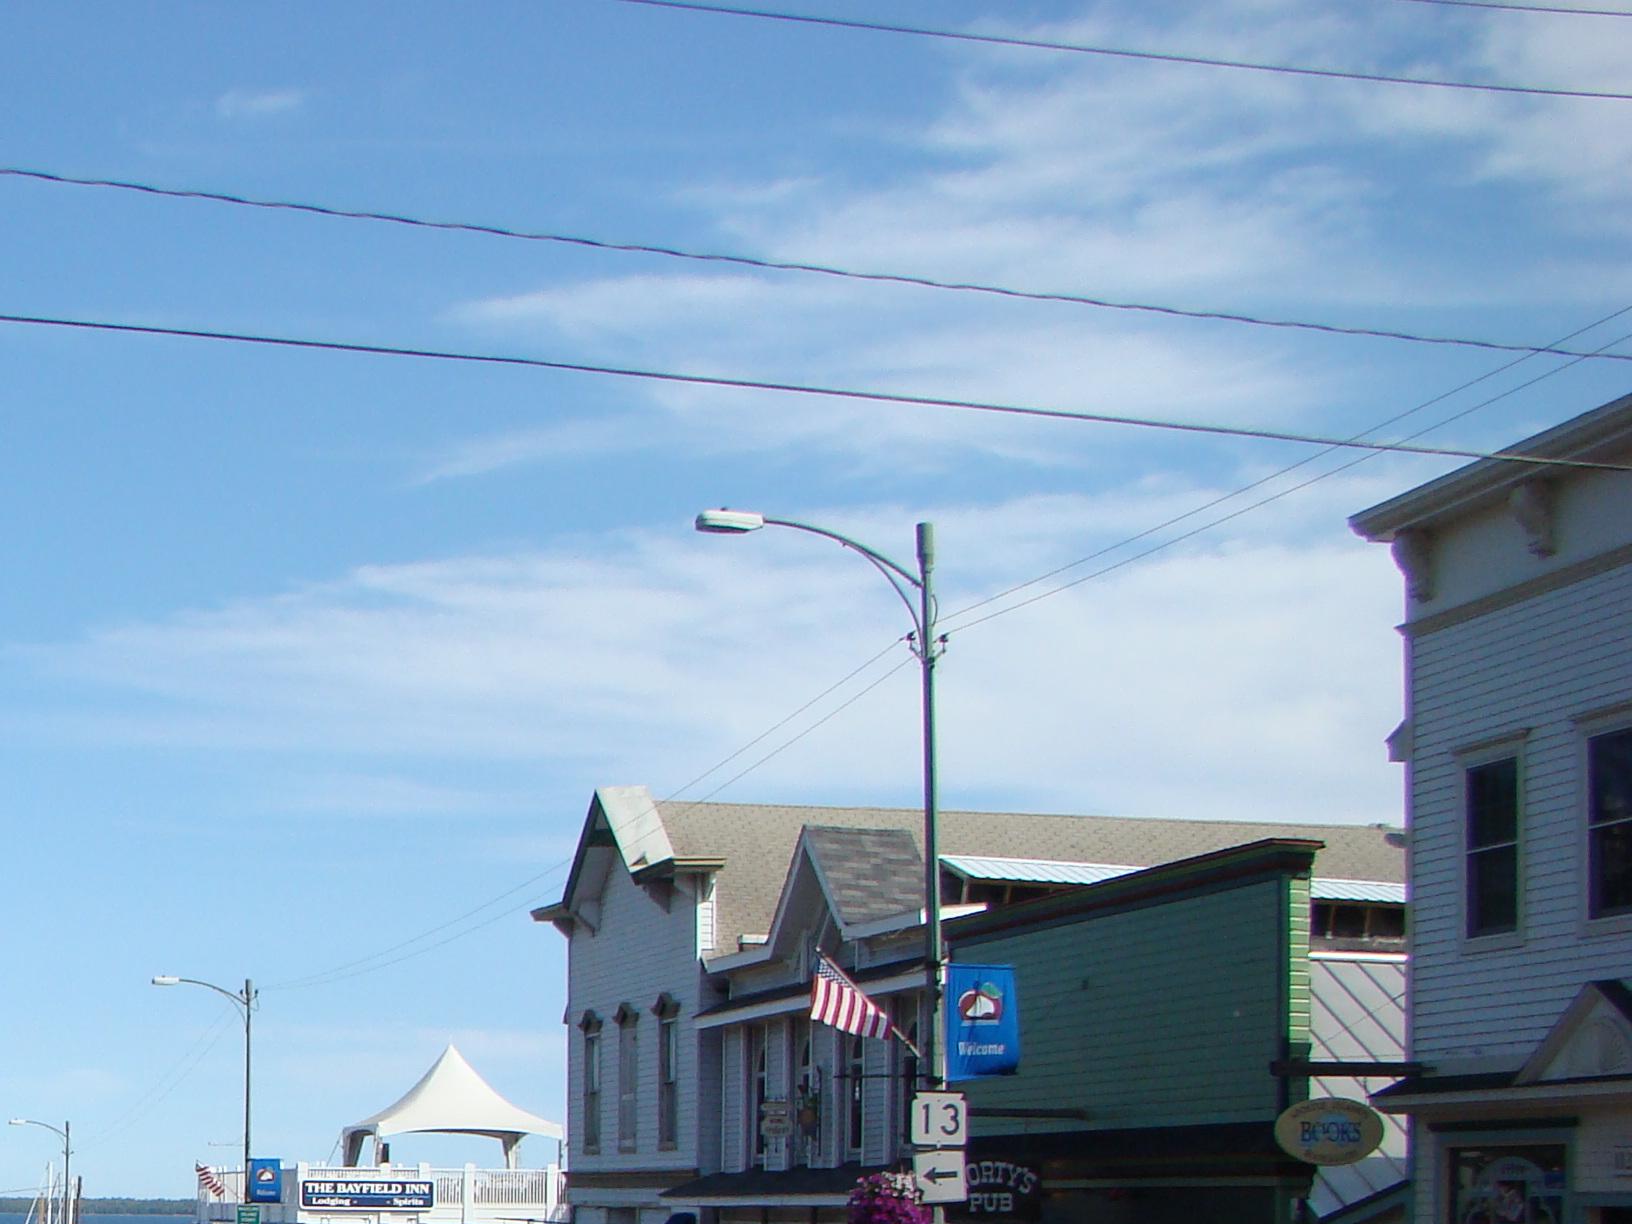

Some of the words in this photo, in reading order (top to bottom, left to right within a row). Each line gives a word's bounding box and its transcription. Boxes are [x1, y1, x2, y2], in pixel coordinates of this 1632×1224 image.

[958, 1041, 1005, 1056] Welcome
[922, 1103, 960, 1135] 13
[1300, 1121, 1361, 1142] BOOKS
[966, 1161, 1037, 1194] ORTY'S
[305, 1183, 334, 1194] THE
[336, 1183, 402, 1194] BAYFIELD
[406, 1183, 430, 1194] INN
[312, 1197, 351, 1206] Lodging
[393, 1197, 424, 1206] Spirits
[969, 1193, 1012, 1212] PUB
